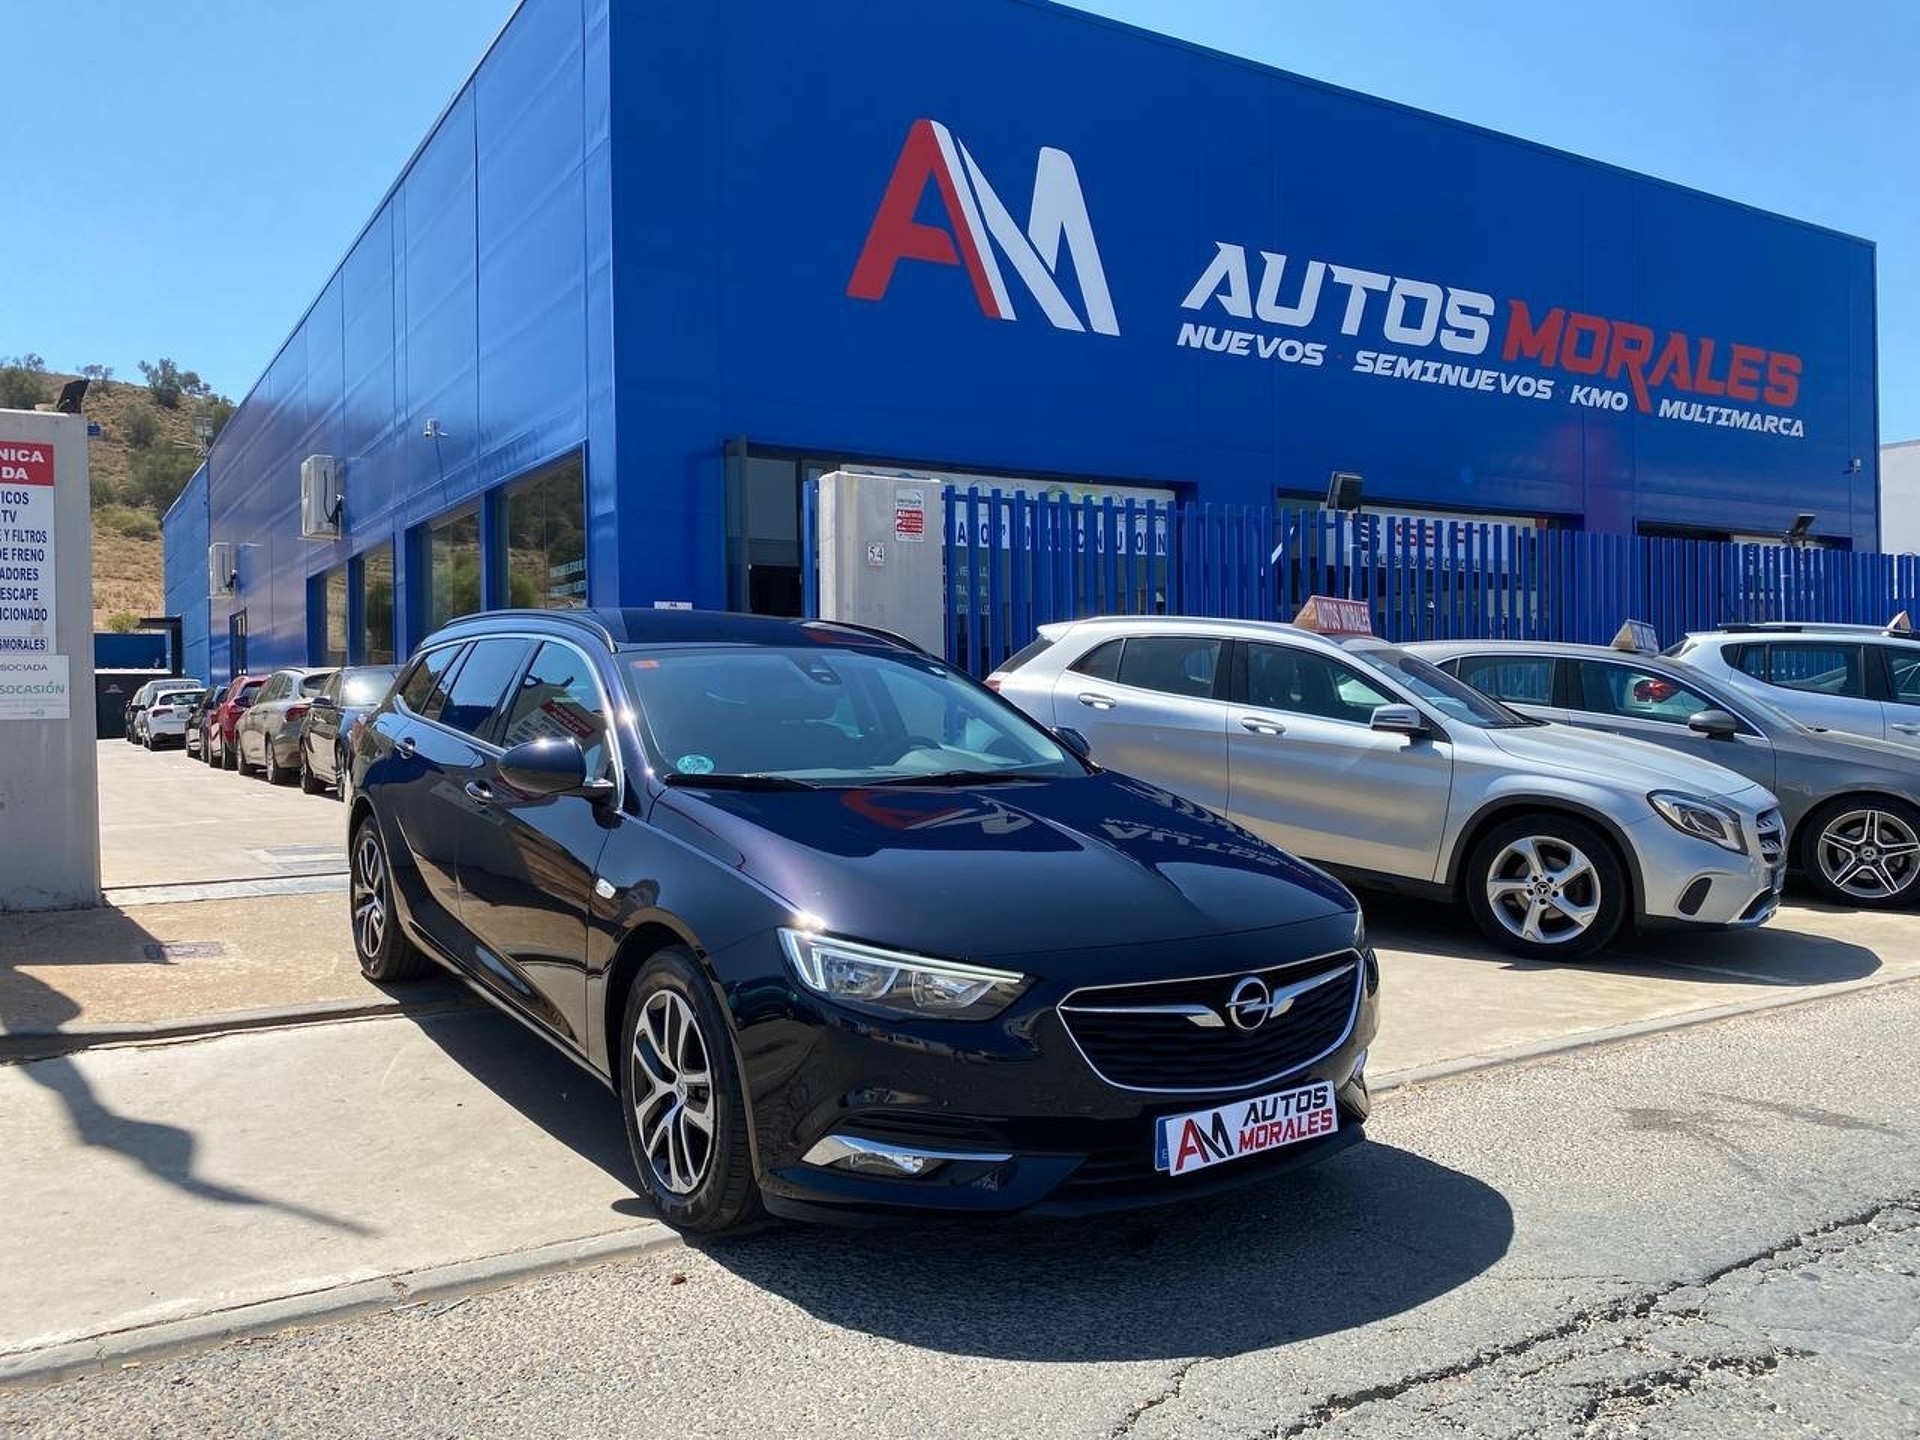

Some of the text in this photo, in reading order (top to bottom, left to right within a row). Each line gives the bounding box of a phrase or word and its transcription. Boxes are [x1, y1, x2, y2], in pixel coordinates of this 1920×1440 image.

[846, 118, 1121, 336] AM
[1181, 241, 1802, 413] AUTOS MORALES
[1177, 323, 1327, 366] NUEVOS
[1353, 350, 1554, 400] SEMINUEVOS
[1659, 399, 1804, 438] MULTIMARCA
[4, 529, 10, 541] Y
[12, 529, 47, 543] FILTROS
[12, 548, 45, 561] FRENO
[0, 587, 39, 601] ESCAPE
[0, 638, 46, 651] MORALES
[1176, 1085, 1328, 1171] AM AUTOS
[1239, 1108, 1333, 1154] MORALES
